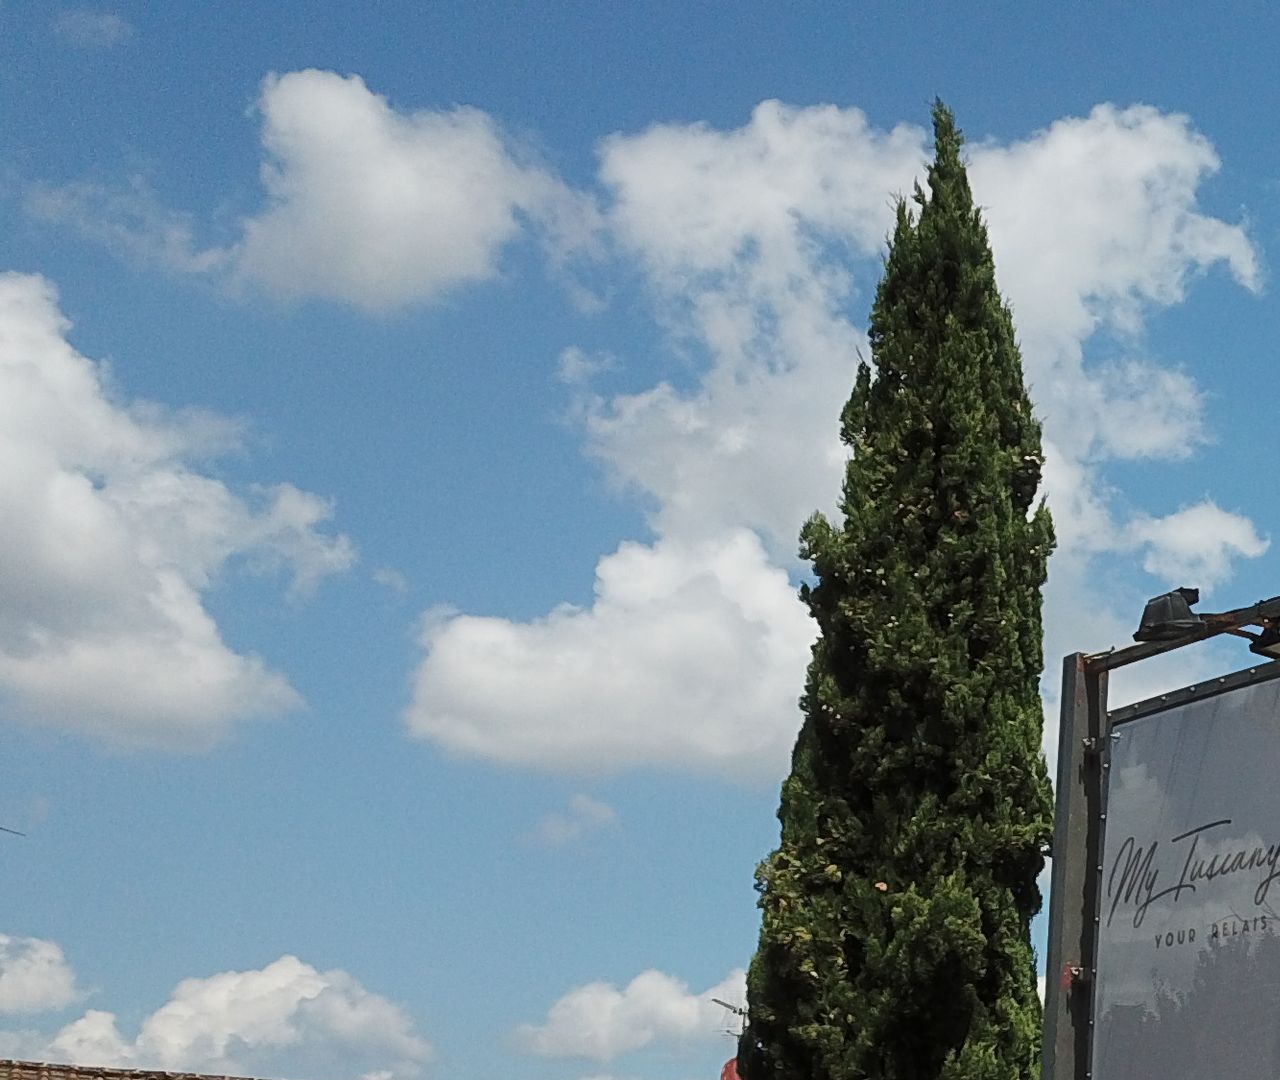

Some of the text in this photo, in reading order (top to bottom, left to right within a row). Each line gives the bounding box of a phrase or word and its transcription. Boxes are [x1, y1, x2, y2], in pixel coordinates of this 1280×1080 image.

[1107, 836, 1196, 928] My
[1155, 916, 1268, 948] YOUR RELAIS
